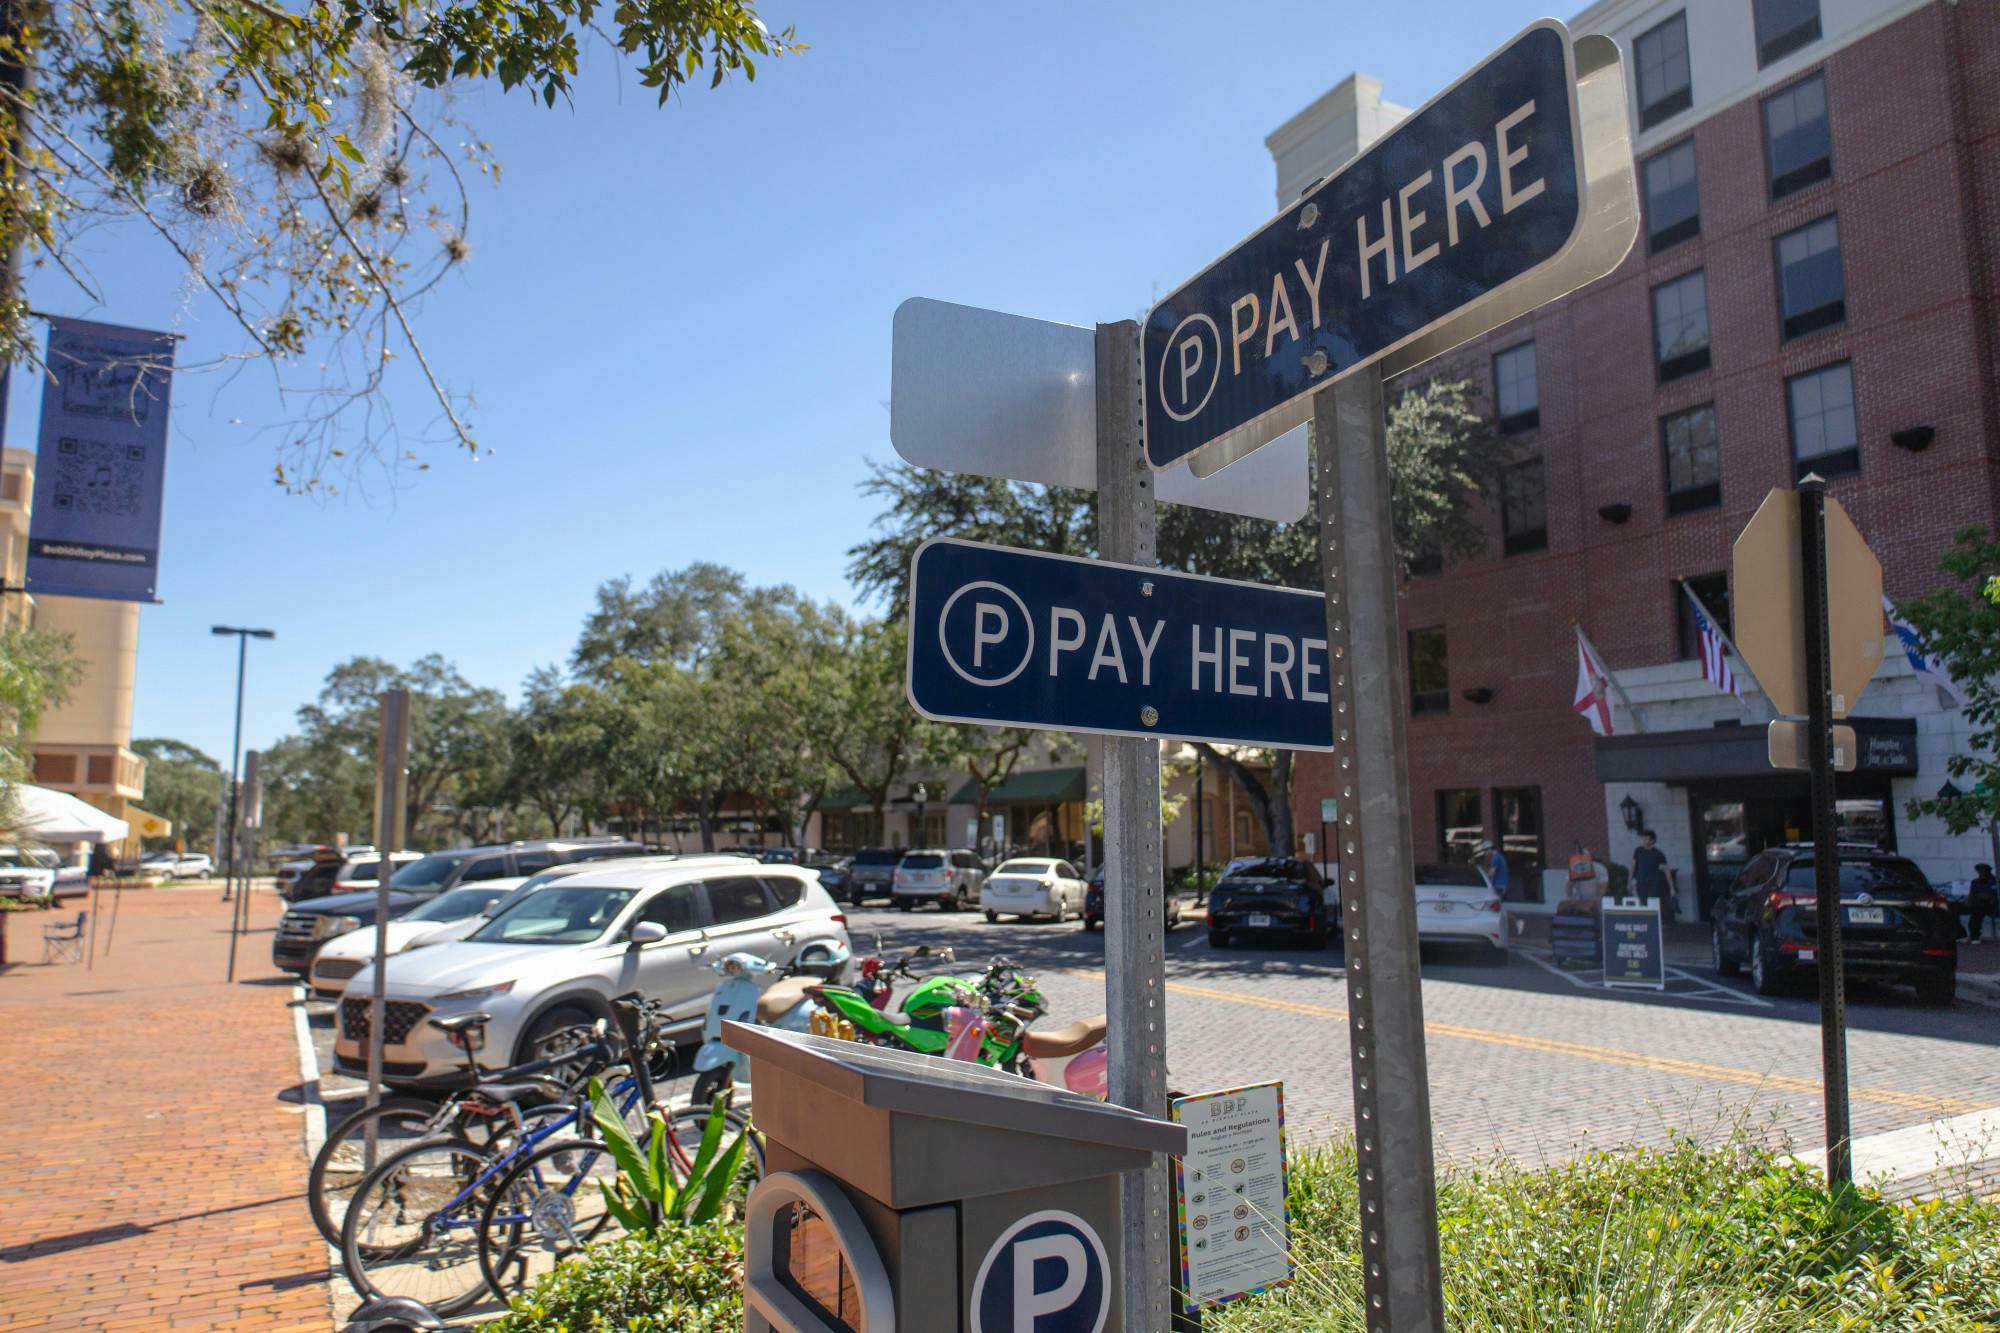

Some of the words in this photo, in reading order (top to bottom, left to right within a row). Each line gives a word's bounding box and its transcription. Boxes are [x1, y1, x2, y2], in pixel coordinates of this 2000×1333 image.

[1180, 335, 1203, 406] P
[1231, 240, 1330, 376] PAY
[1356, 98, 1546, 300] HERE
[973, 602, 1009, 668] P
[1049, 605, 1167, 686] PAY
[1191, 623, 1330, 703] HERE
[1191, 1130, 1212, 1139] Rules
[1213, 1126, 1227, 1134] and
[1229, 1117, 1271, 1131] Regulations
[1210, 1097, 1248, 1117] BBP
[1013, 1233, 1088, 1333] P
